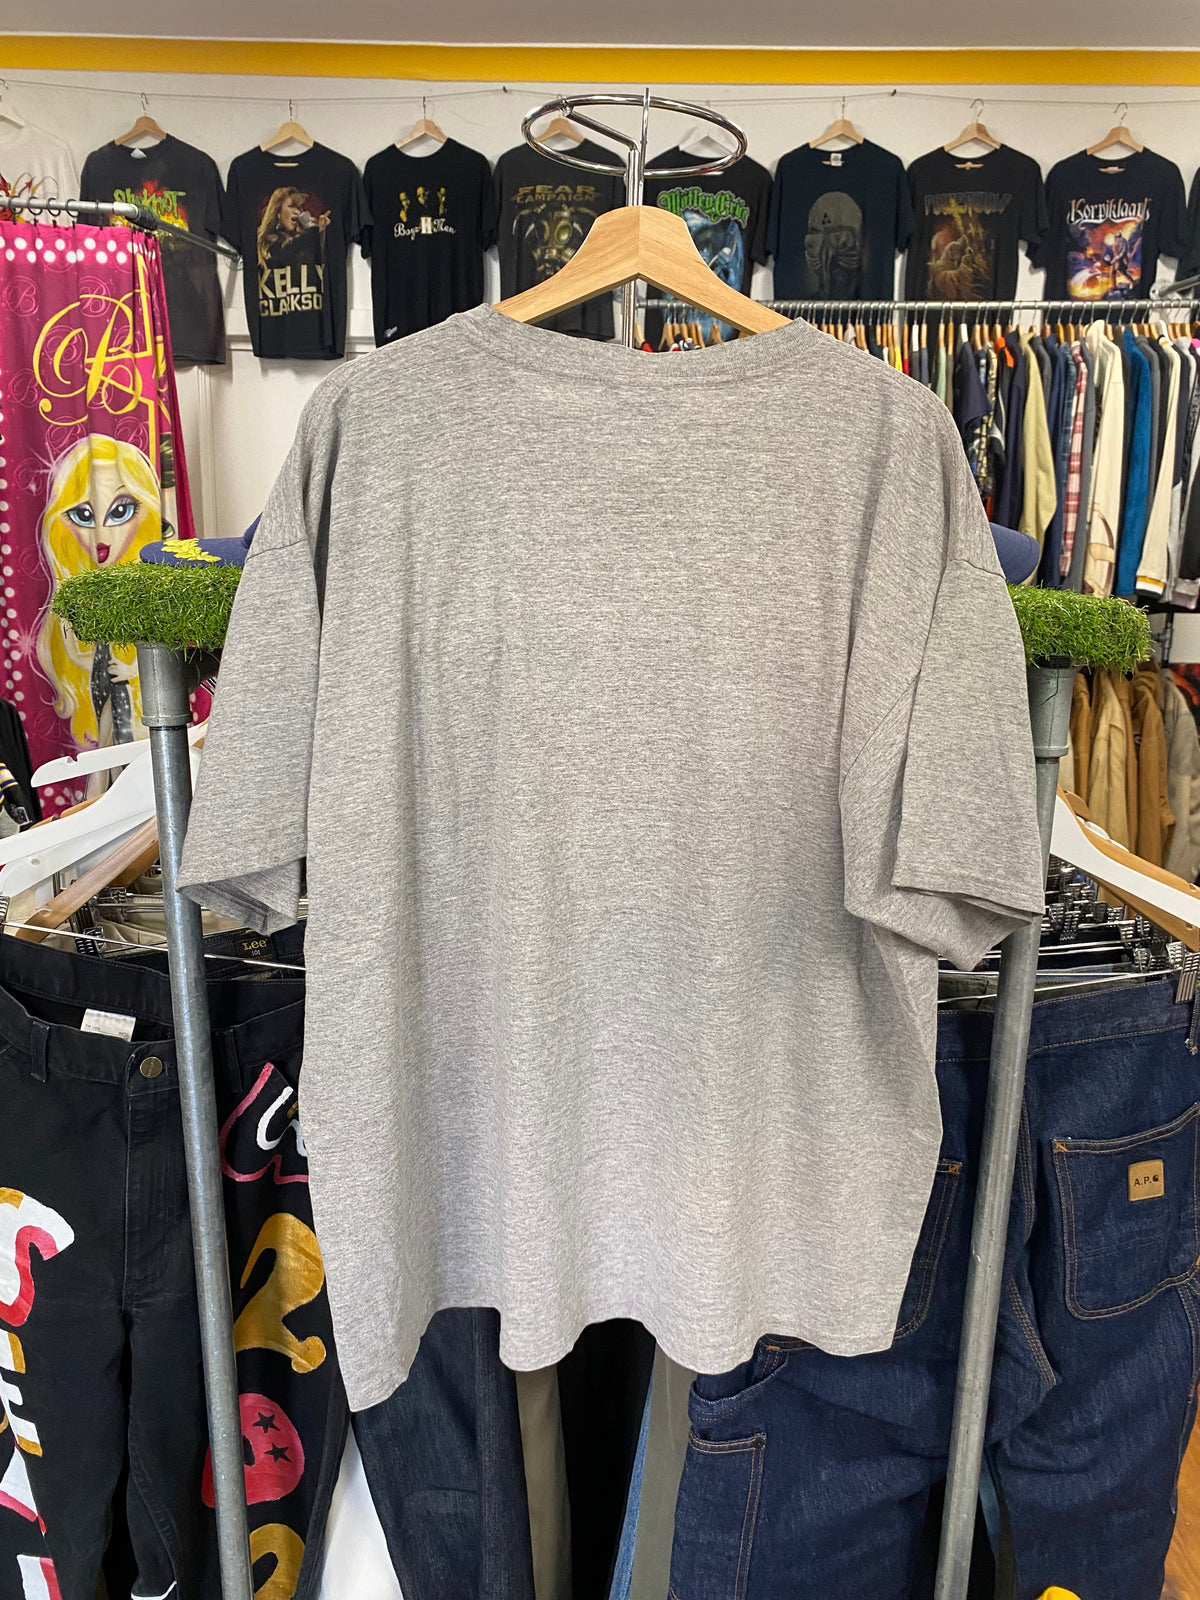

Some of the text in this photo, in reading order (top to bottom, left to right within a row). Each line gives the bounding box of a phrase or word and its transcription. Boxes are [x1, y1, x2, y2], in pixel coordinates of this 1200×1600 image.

[516, 184, 597, 196] FEAR
[515, 193, 597, 204] CAMPAIGN
[258, 264, 326, 299] KELLY
[242, 939, 267, 951] Lee
